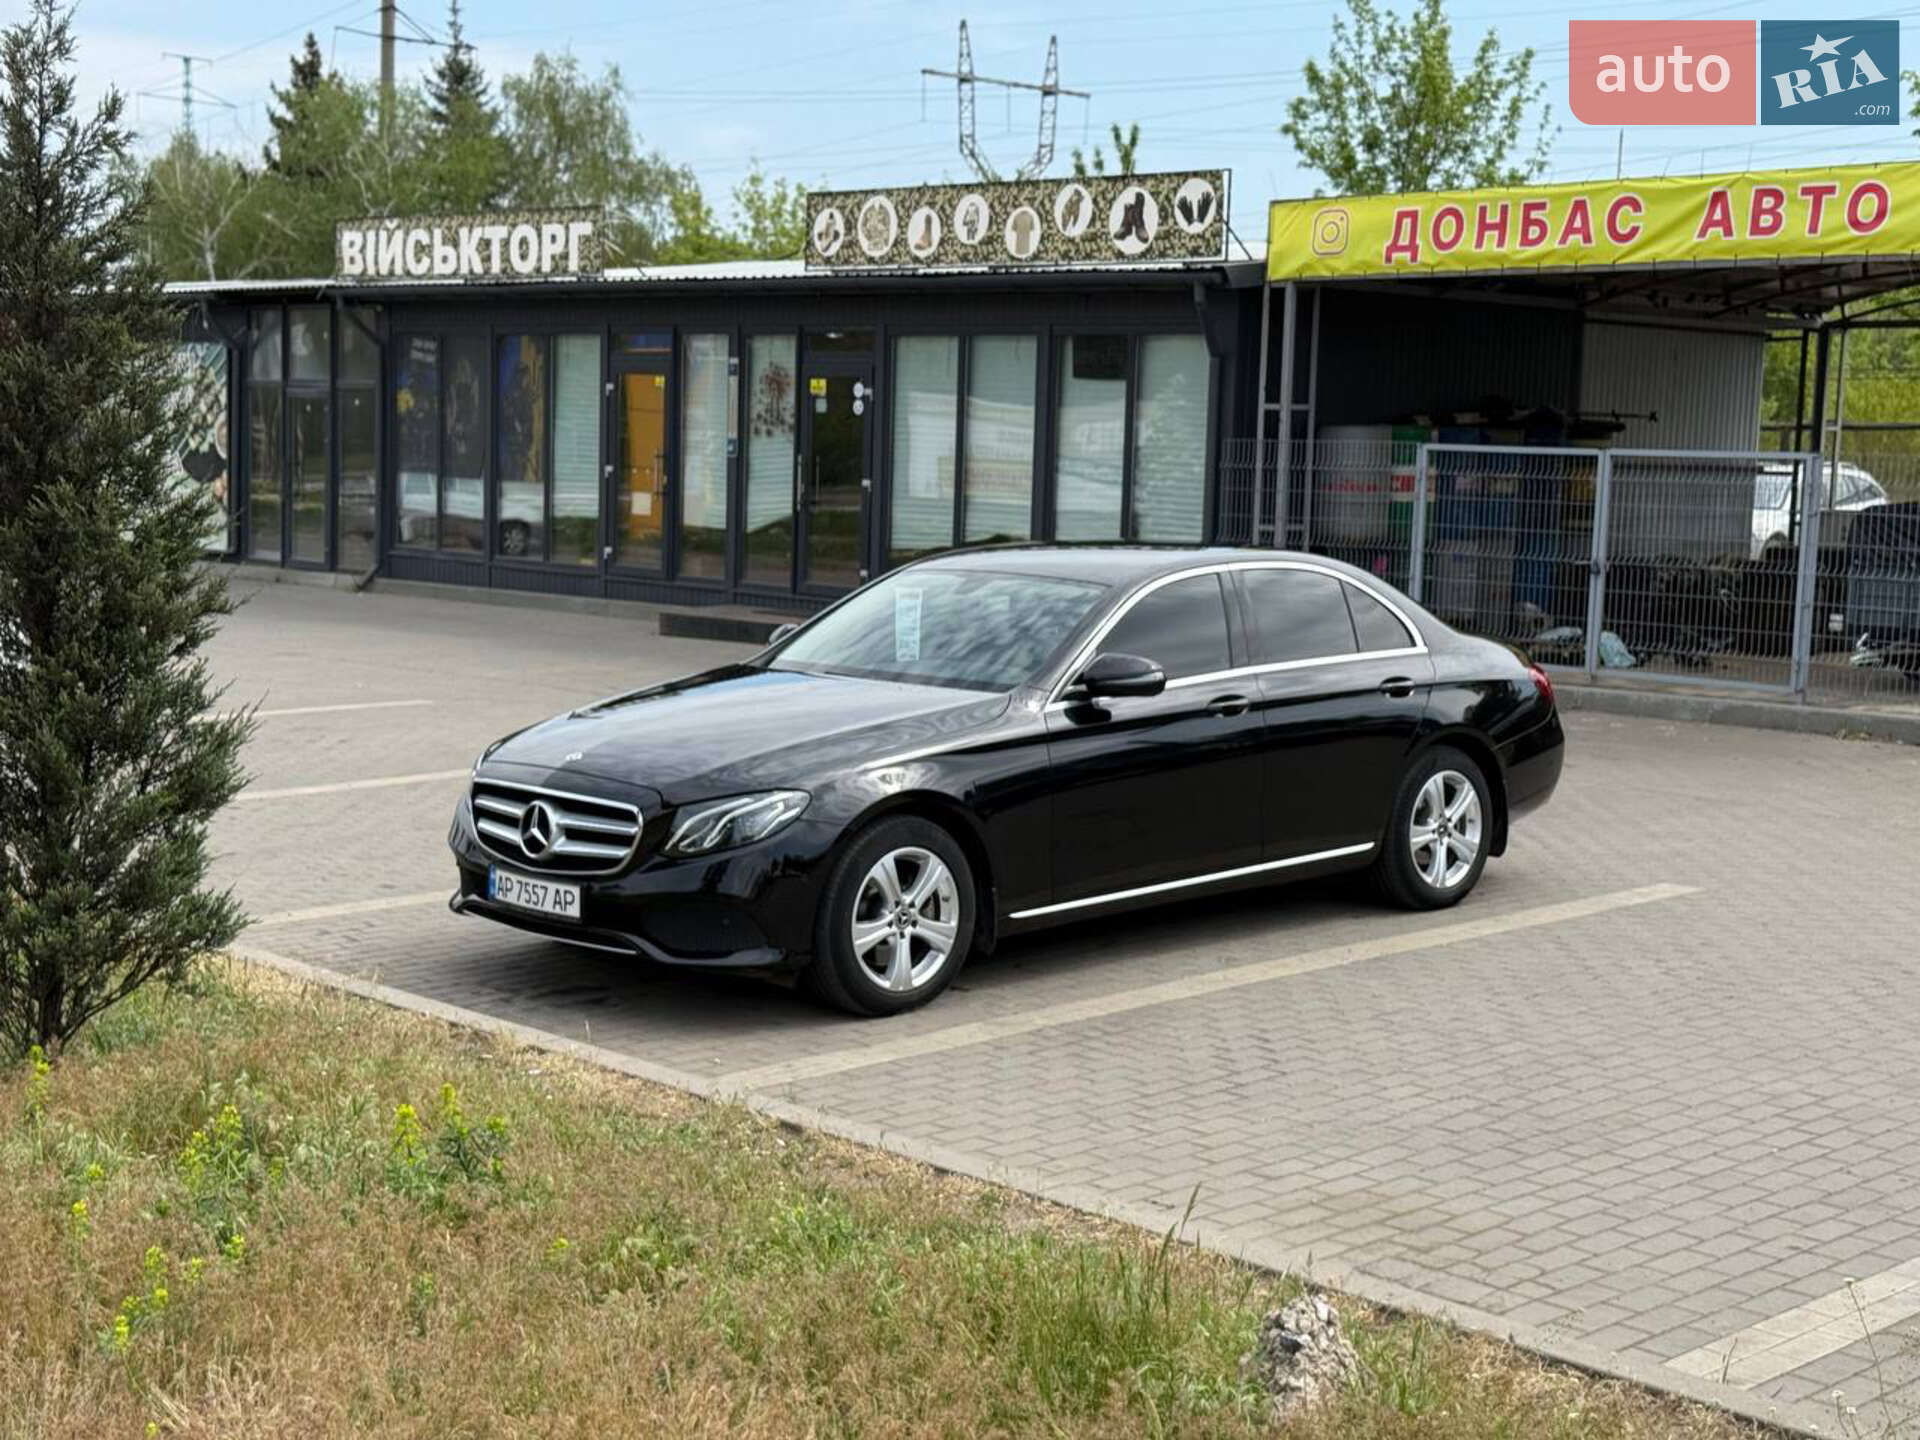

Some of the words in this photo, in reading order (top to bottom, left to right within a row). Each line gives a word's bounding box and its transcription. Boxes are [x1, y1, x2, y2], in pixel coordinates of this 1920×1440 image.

[340, 218, 593, 276] ВІЙСЬКТОРГ
[1384, 194, 1643, 264] ДОНБАС
[1696, 181, 1890, 241] АВТО
[516, 879, 549, 908] 7557
[552, 887, 576, 912] AP
